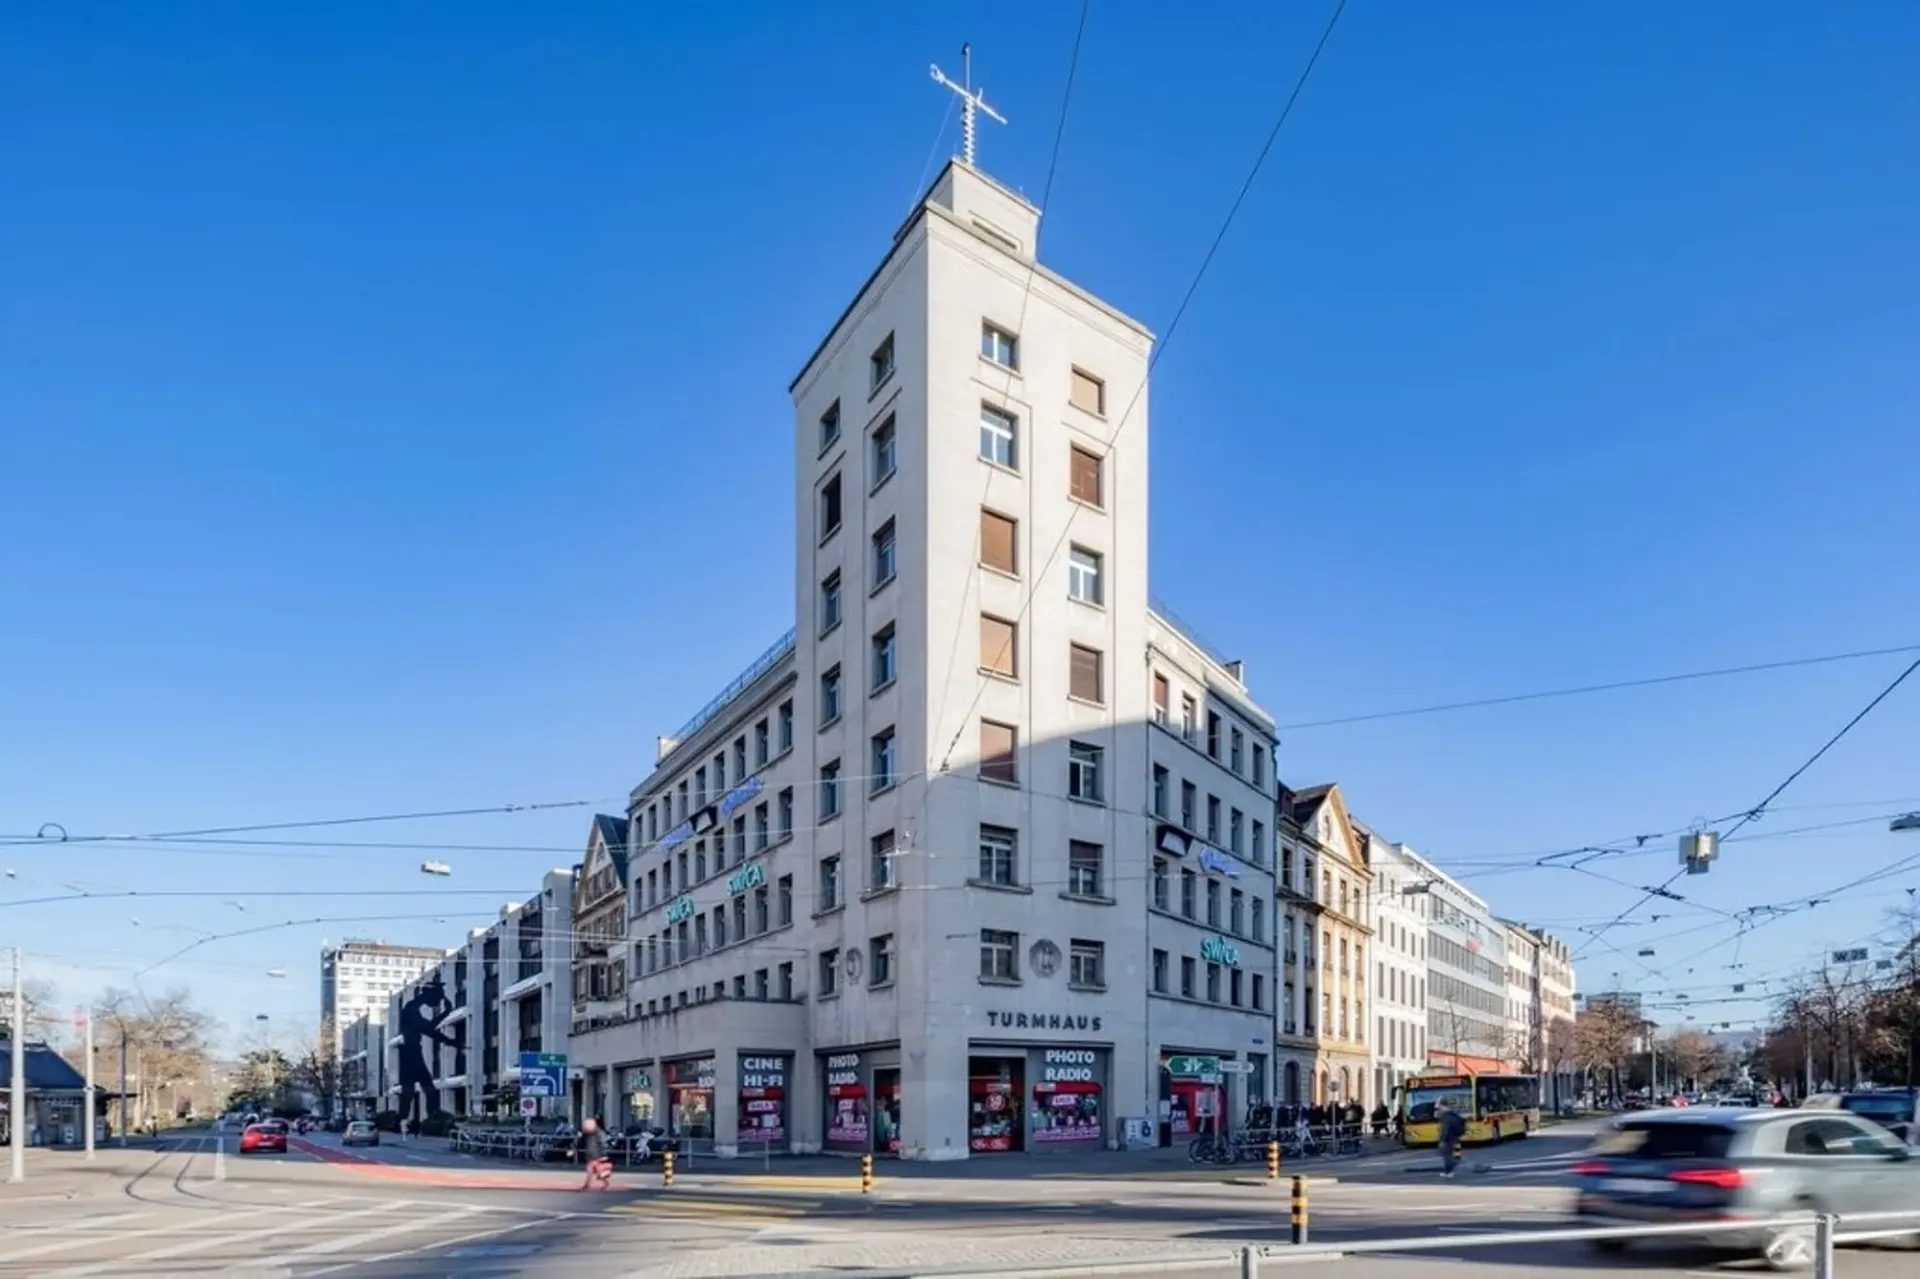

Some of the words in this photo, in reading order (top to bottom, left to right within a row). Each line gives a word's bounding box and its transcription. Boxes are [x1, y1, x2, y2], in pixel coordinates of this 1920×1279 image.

[987, 1011, 1102, 1031] TURMHAUS
[828, 1053, 860, 1069] PHOTO
[1046, 1049, 1095, 1064] PHOTO
[743, 1057, 784, 1071] CINE
[743, 1074, 783, 1087] HI-FI
[828, 1071, 858, 1085] RADIO
[1045, 1067, 1092, 1081] RADIO
